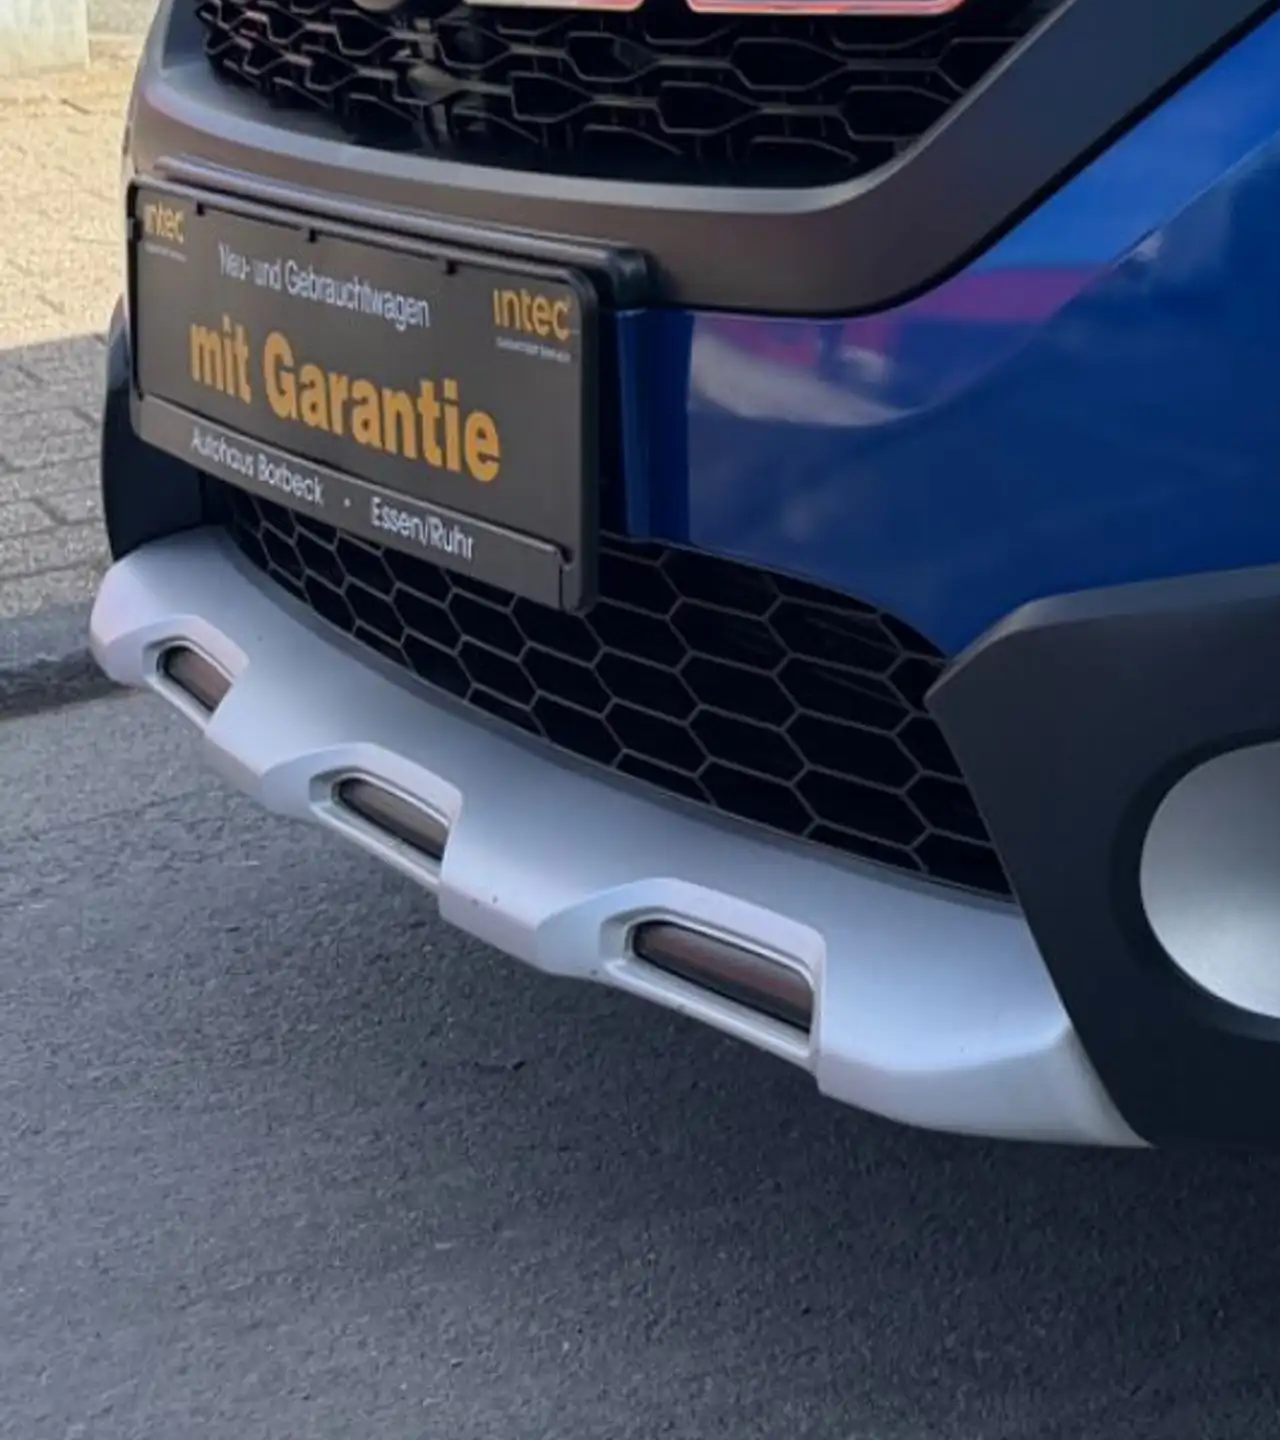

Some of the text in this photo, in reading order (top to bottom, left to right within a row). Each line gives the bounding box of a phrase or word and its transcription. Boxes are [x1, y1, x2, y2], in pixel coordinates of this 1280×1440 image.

[218, 244, 252, 280] Neu-
[253, 258, 282, 291] und
[284, 259, 431, 332] Gebrauchtwagen
[190, 314, 501, 483] mit Garantie
[190, 427, 476, 561] Autohaus Borbeck Essen/Ruhr
